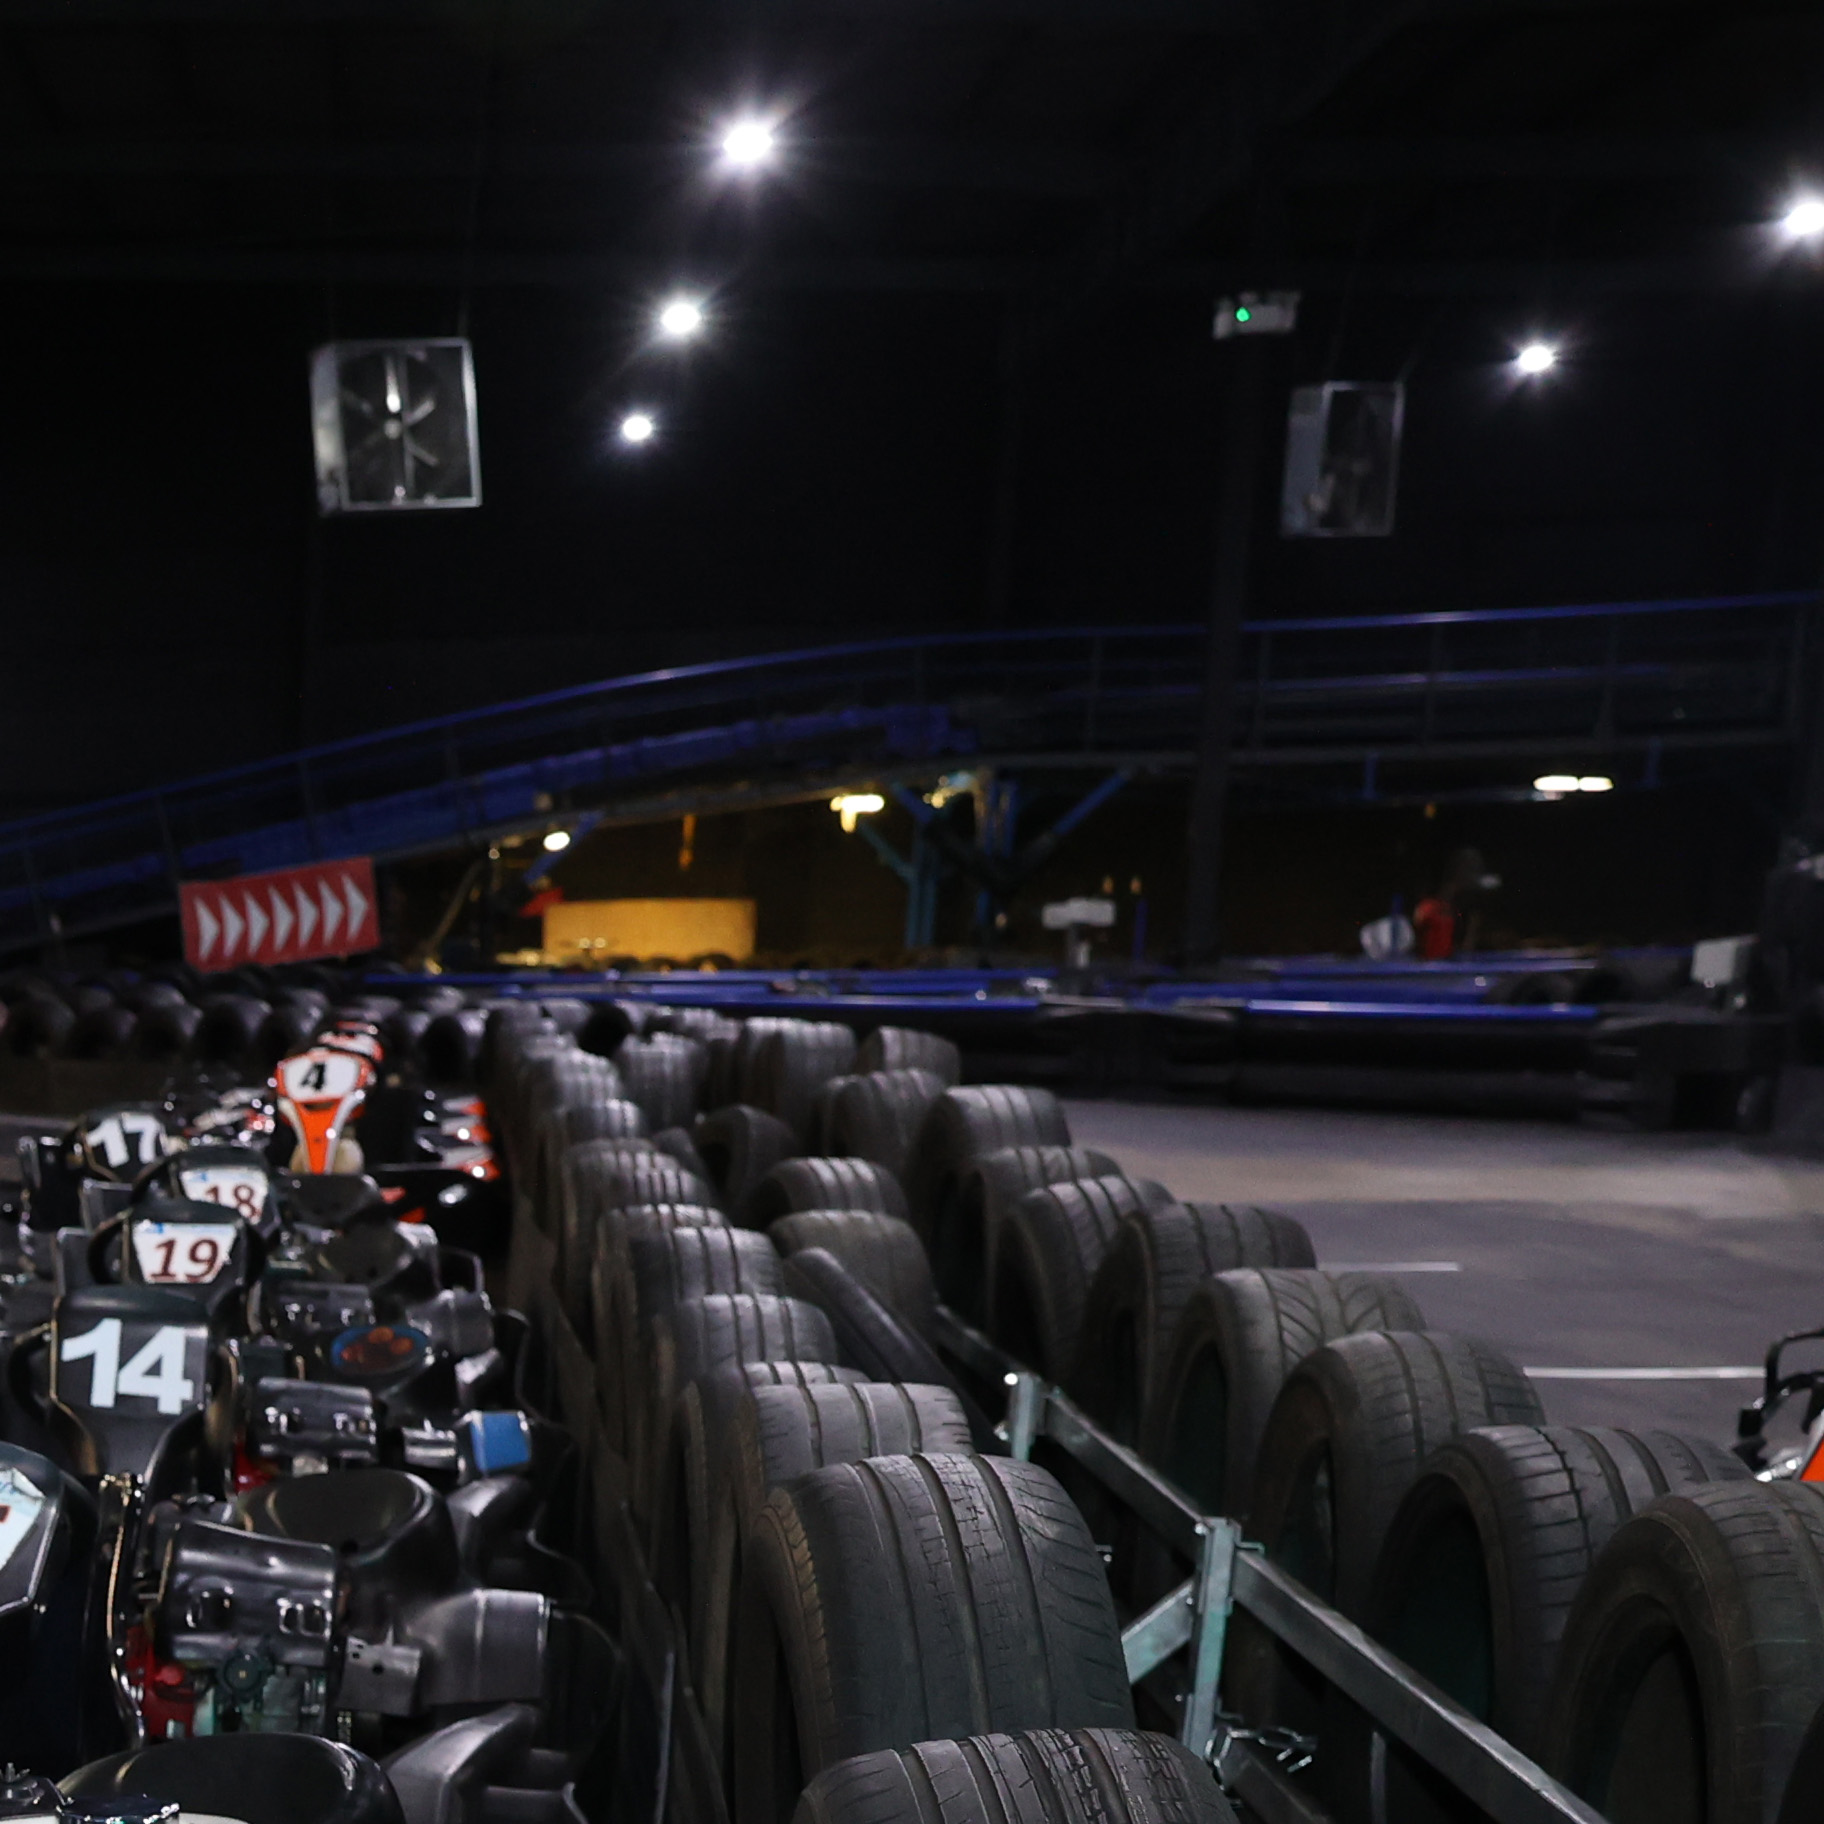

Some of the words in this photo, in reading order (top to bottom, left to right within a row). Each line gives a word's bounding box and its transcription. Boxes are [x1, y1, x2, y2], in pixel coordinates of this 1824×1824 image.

[299, 1062, 328, 1093] 4
[85, 1112, 159, 1168] 17
[151, 1238, 219, 1280] 19
[61, 1317, 194, 1415] 14
